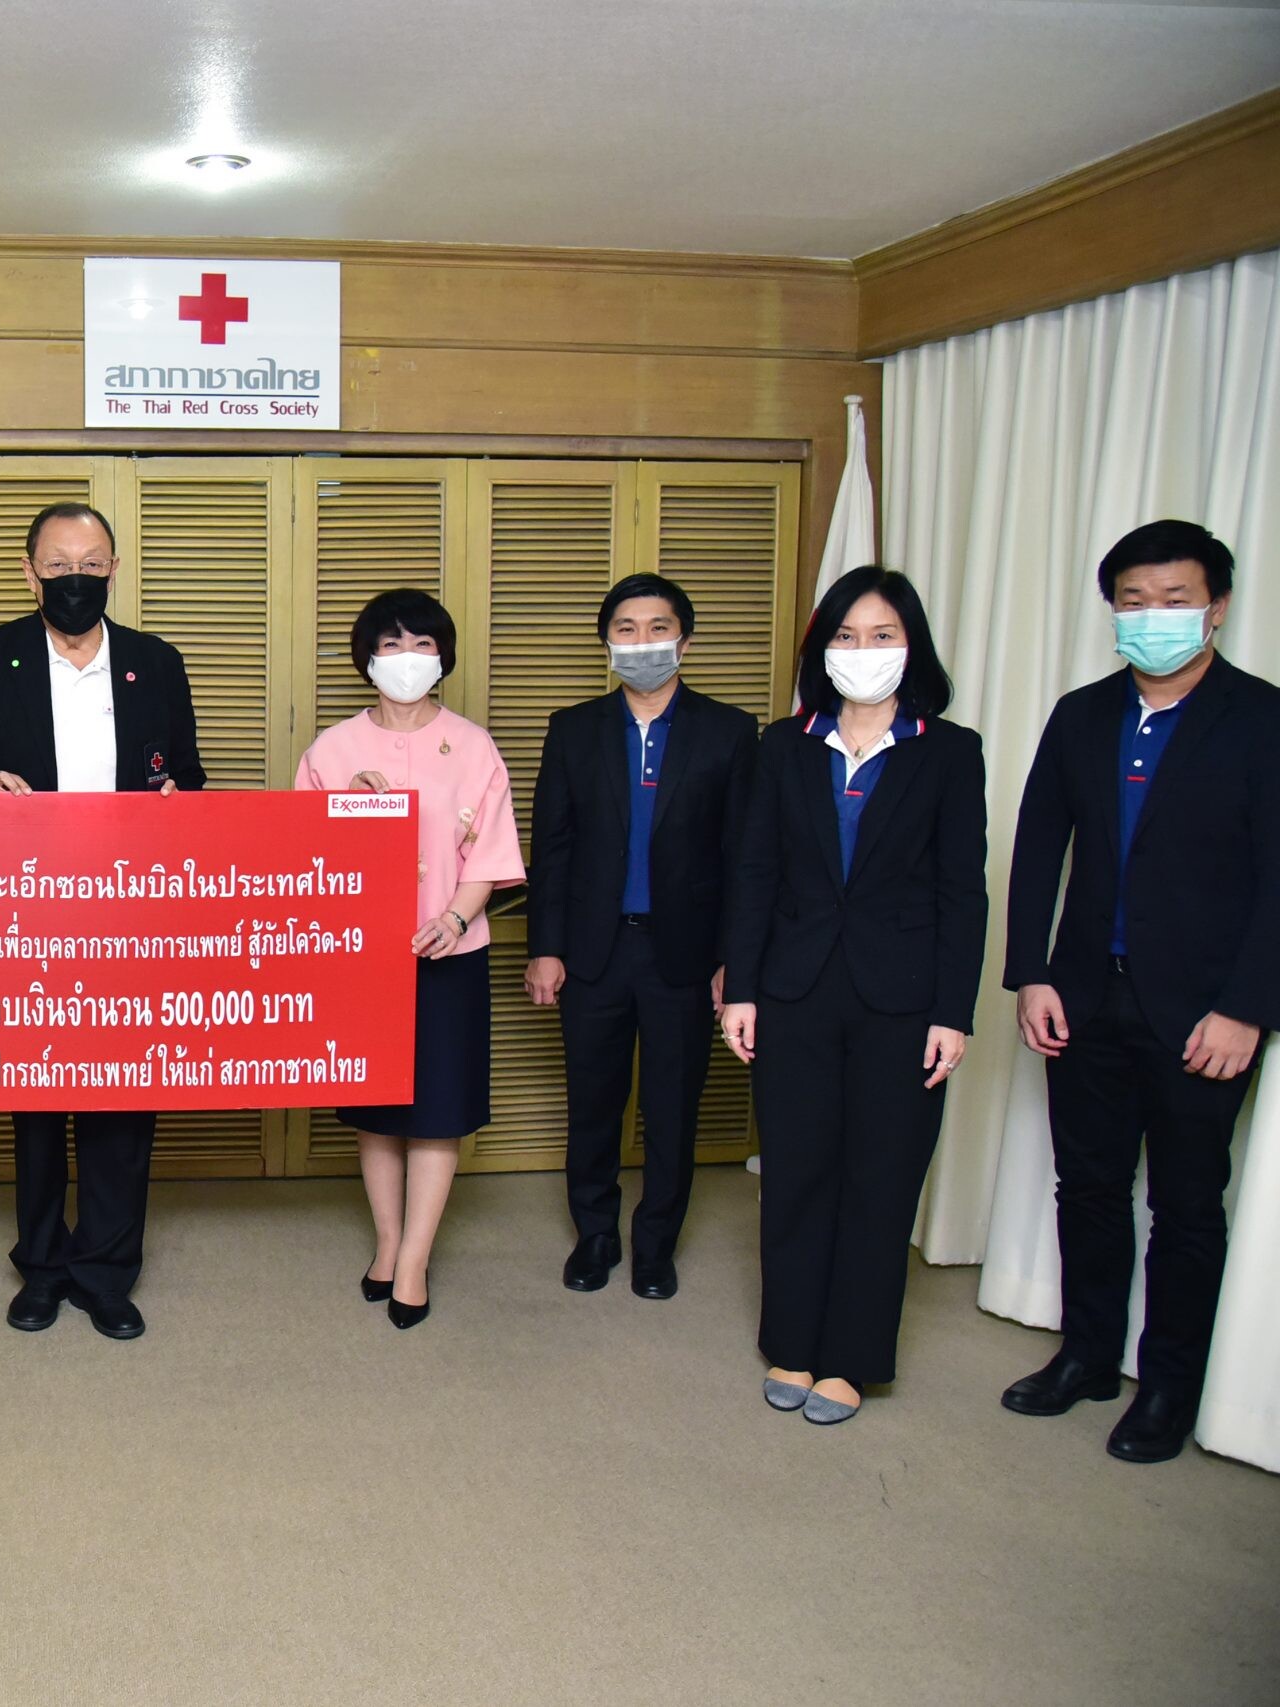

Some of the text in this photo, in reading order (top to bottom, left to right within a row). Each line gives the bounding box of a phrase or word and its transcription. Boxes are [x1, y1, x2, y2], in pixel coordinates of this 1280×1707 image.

[104, 357, 320, 390] สภากาชาดไทย
[106, 399, 319, 418] The Thai Red Cross Society
[331, 798, 405, 812] ExxonMobil
[248, 918, 364, 970] สู้ภัยโควิด-19
[160, 990, 255, 1032] 500,000
[261, 992, 314, 1024] บาท
[157, 1043, 214, 1087] ให้แก่
[219, 1039, 368, 1087] สภากาชาดไทย
